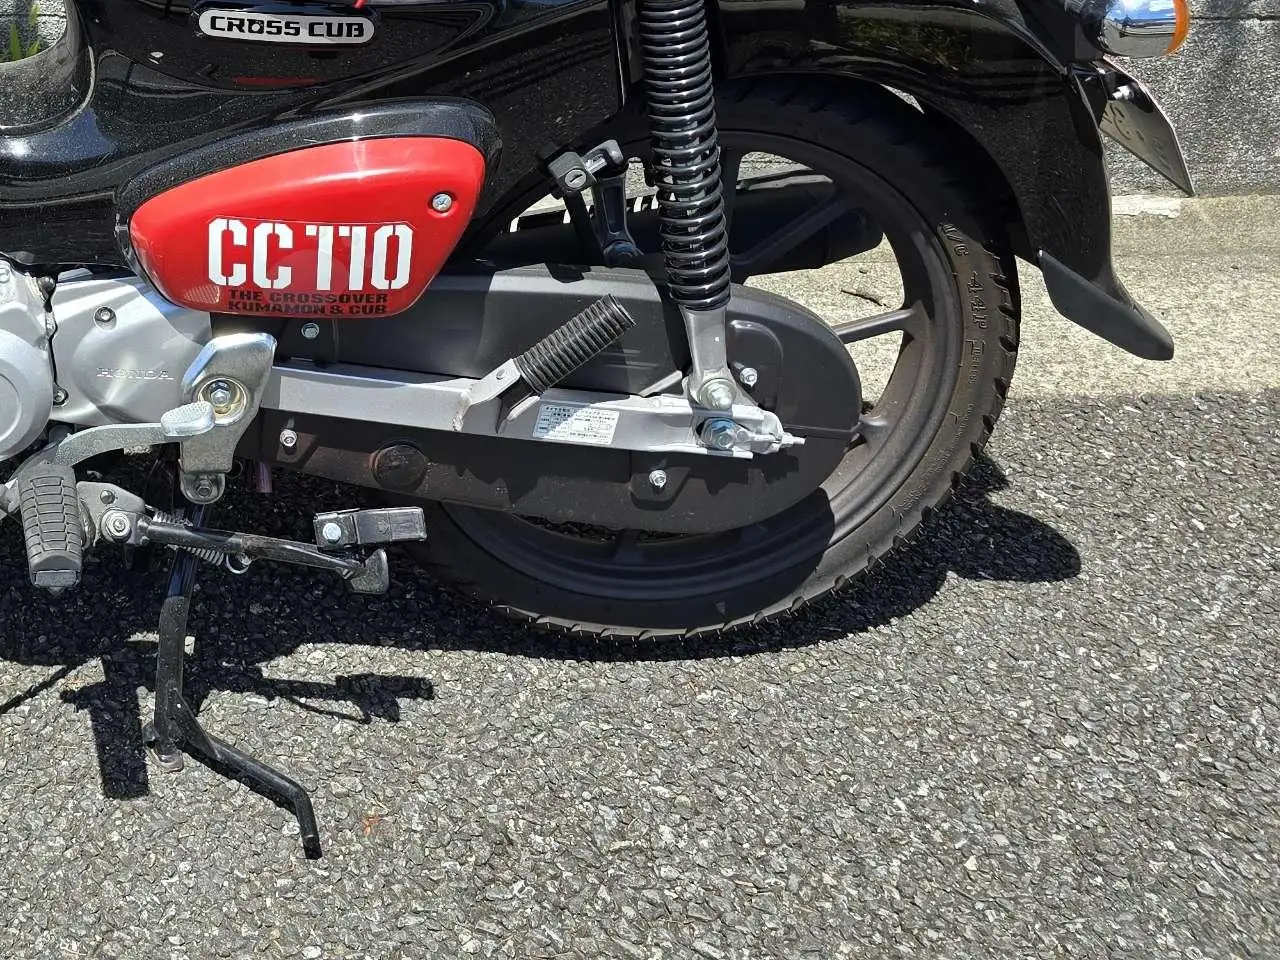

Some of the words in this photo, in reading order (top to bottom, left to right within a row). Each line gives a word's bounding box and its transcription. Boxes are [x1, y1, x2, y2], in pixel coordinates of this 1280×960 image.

[210, 15, 301, 36] CROSS
[308, 22, 365, 38] CUB
[208, 218, 294, 289] CC
[305, 224, 414, 290] 110
[231, 290, 265, 301] THE
[271, 292, 389, 304] CROSSOVER
[228, 301, 326, 314] KUMAMON
[329, 303, 343, 314] &
[349, 304, 388, 315] CUB
[96, 367, 175, 381] HONDA
